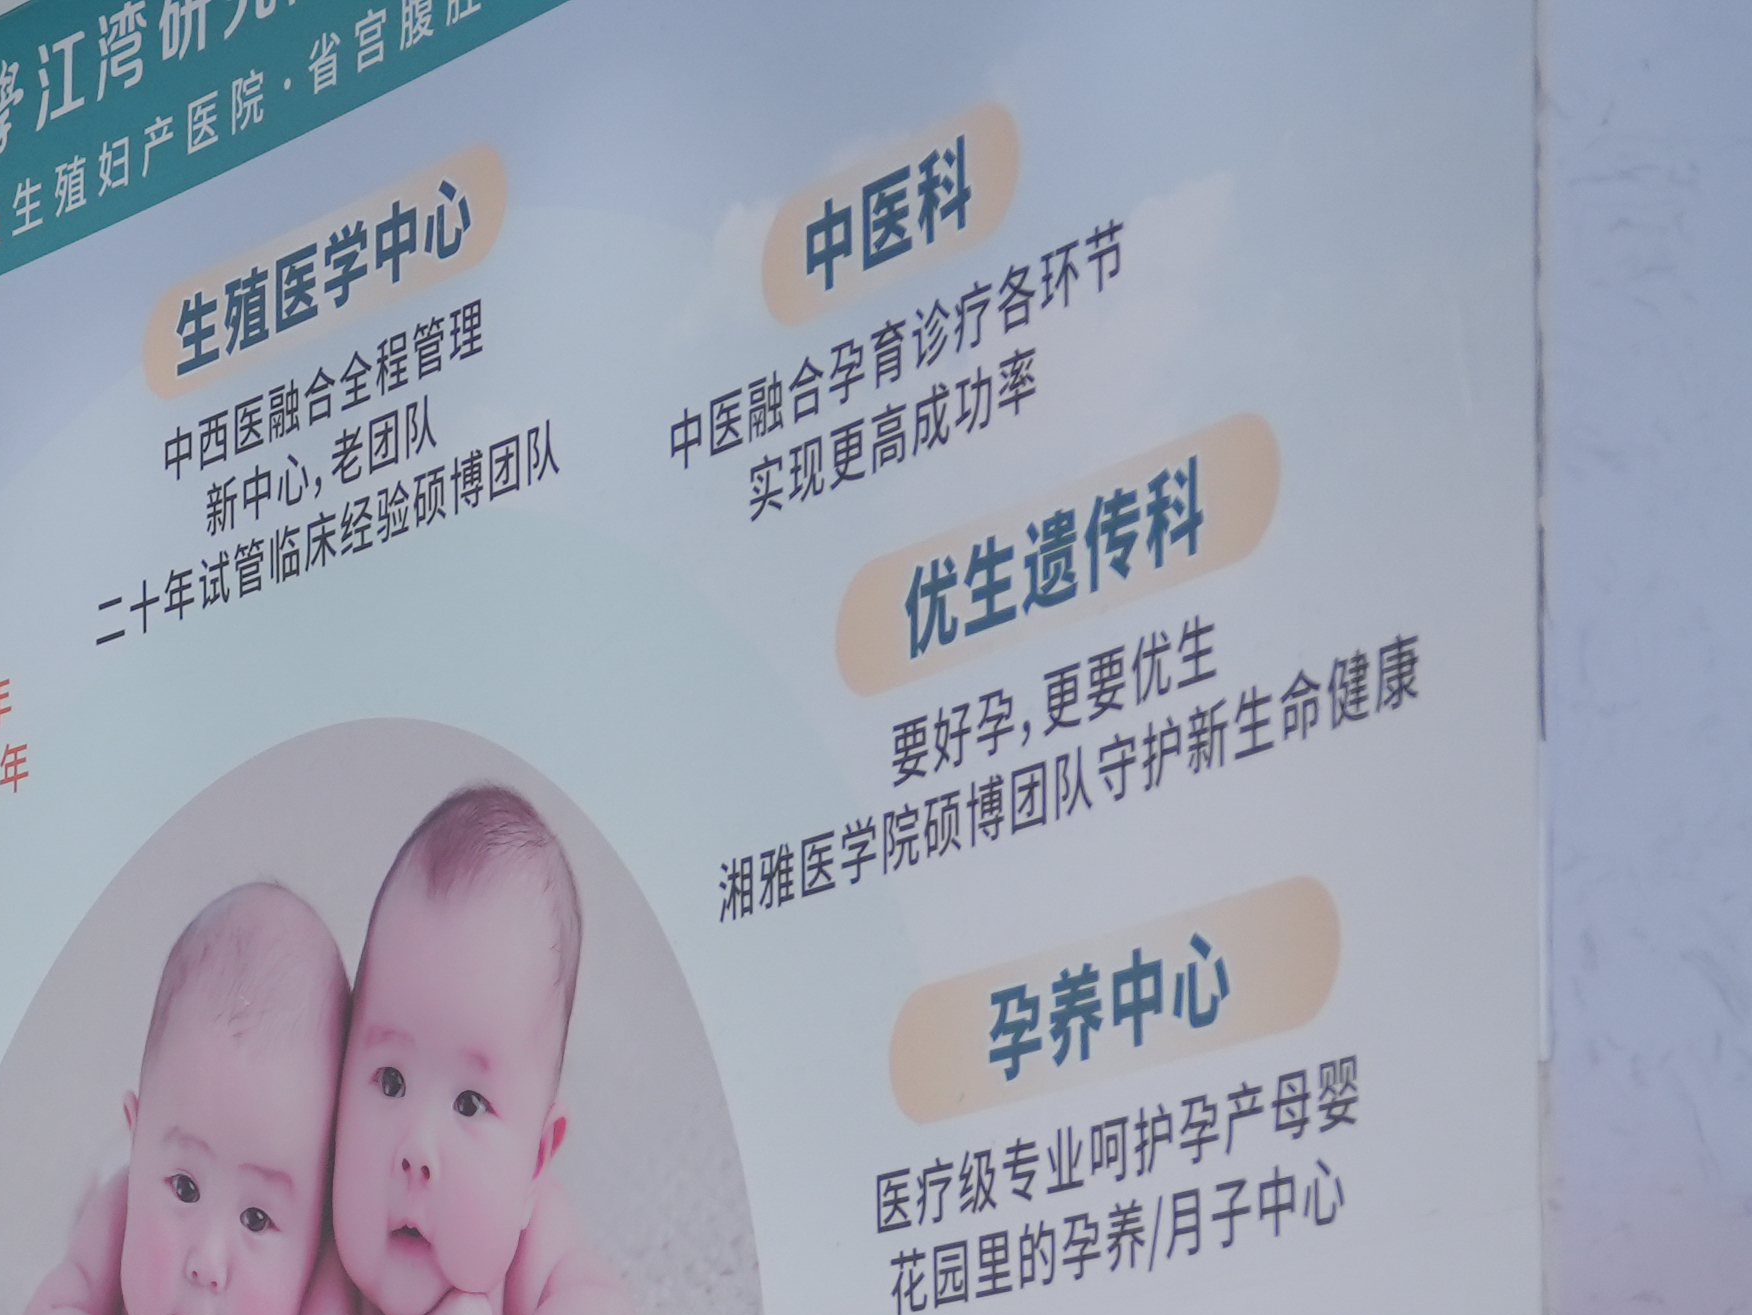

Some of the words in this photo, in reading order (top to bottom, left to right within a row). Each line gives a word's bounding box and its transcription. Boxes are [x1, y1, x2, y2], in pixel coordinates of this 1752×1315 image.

[175, 179, 472, 376] 生殖医学中心
[806, 134, 972, 292] 中医科
[163, 298, 483, 481] 中西医融合全程管理
[670, 219, 1124, 470] 中医融合孕育诊疗各环节
[749, 346, 1037, 522] 实现更高成功率
[96, 419, 560, 646] 二十年试管临床经验硕博团队
[905, 455, 1204, 659] 优生遗传科
[719, 633, 1421, 924] 湘雅医学院硕博团队守护新生命健康
[988, 932, 1230, 1081] 孕养中心
[876, 1055, 1358, 1234] 医疗级专业呵护孕产母婴
[891, 1158, 1344, 1315] 花园里的孕养/月子中心
